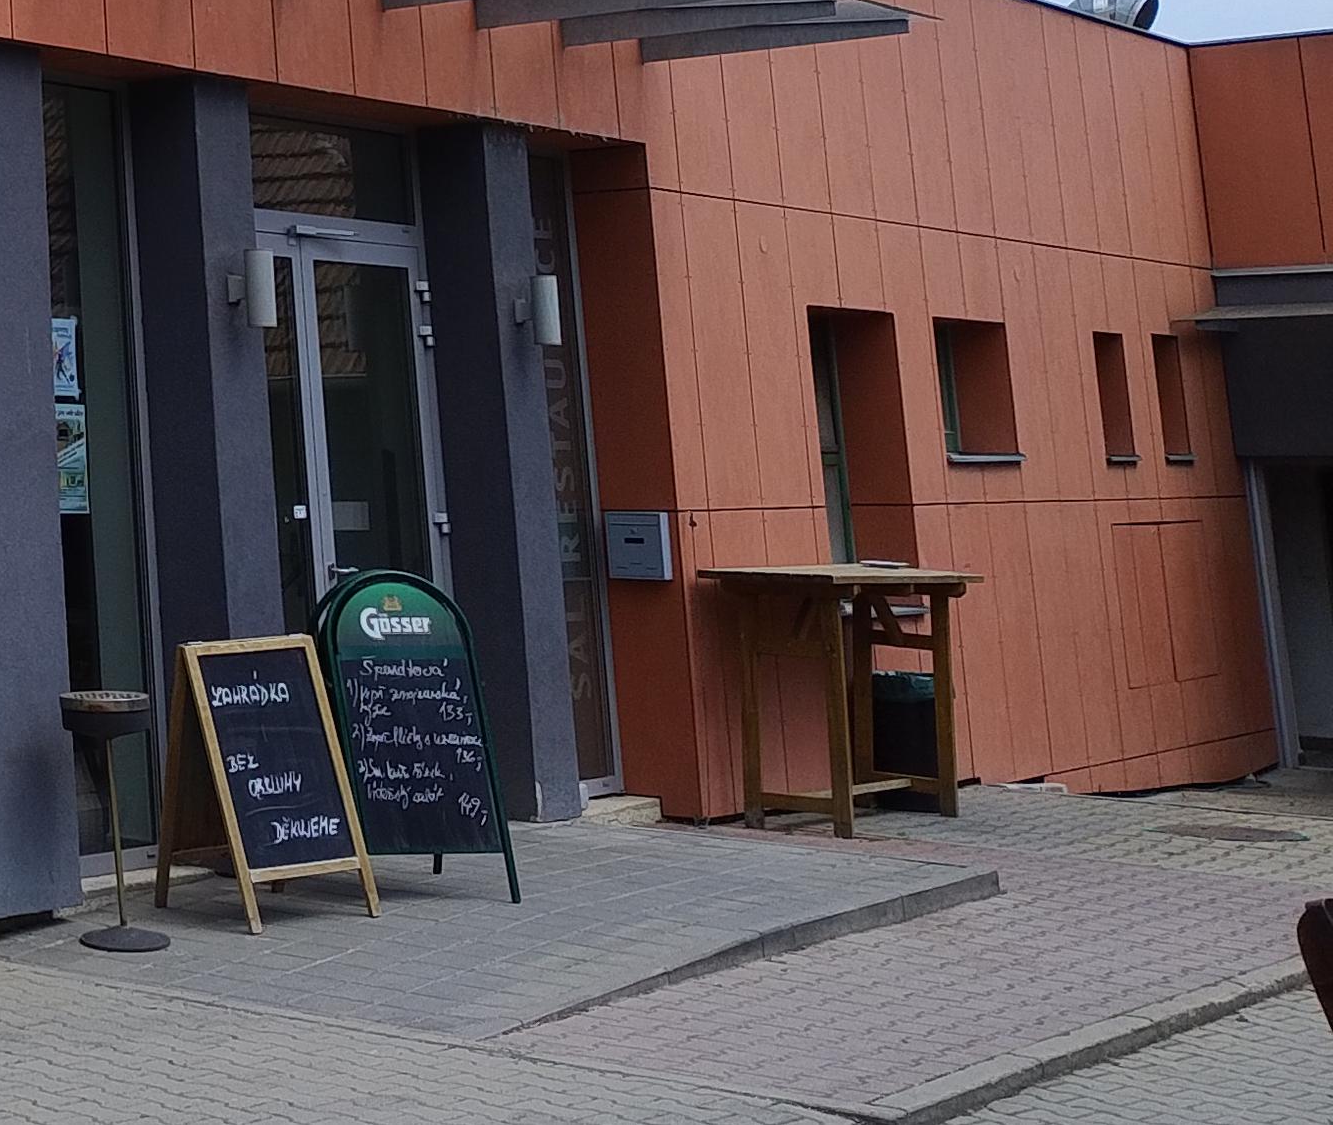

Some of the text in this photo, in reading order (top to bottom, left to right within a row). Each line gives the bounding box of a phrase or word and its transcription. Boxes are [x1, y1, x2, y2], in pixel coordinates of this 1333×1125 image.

[534, 217, 582, 562] RESTAUCE
[359, 607, 432, 641] Gösser
[226, 753, 260, 773] BEZ
[270, 815, 341, 844] DĚKUJEME
